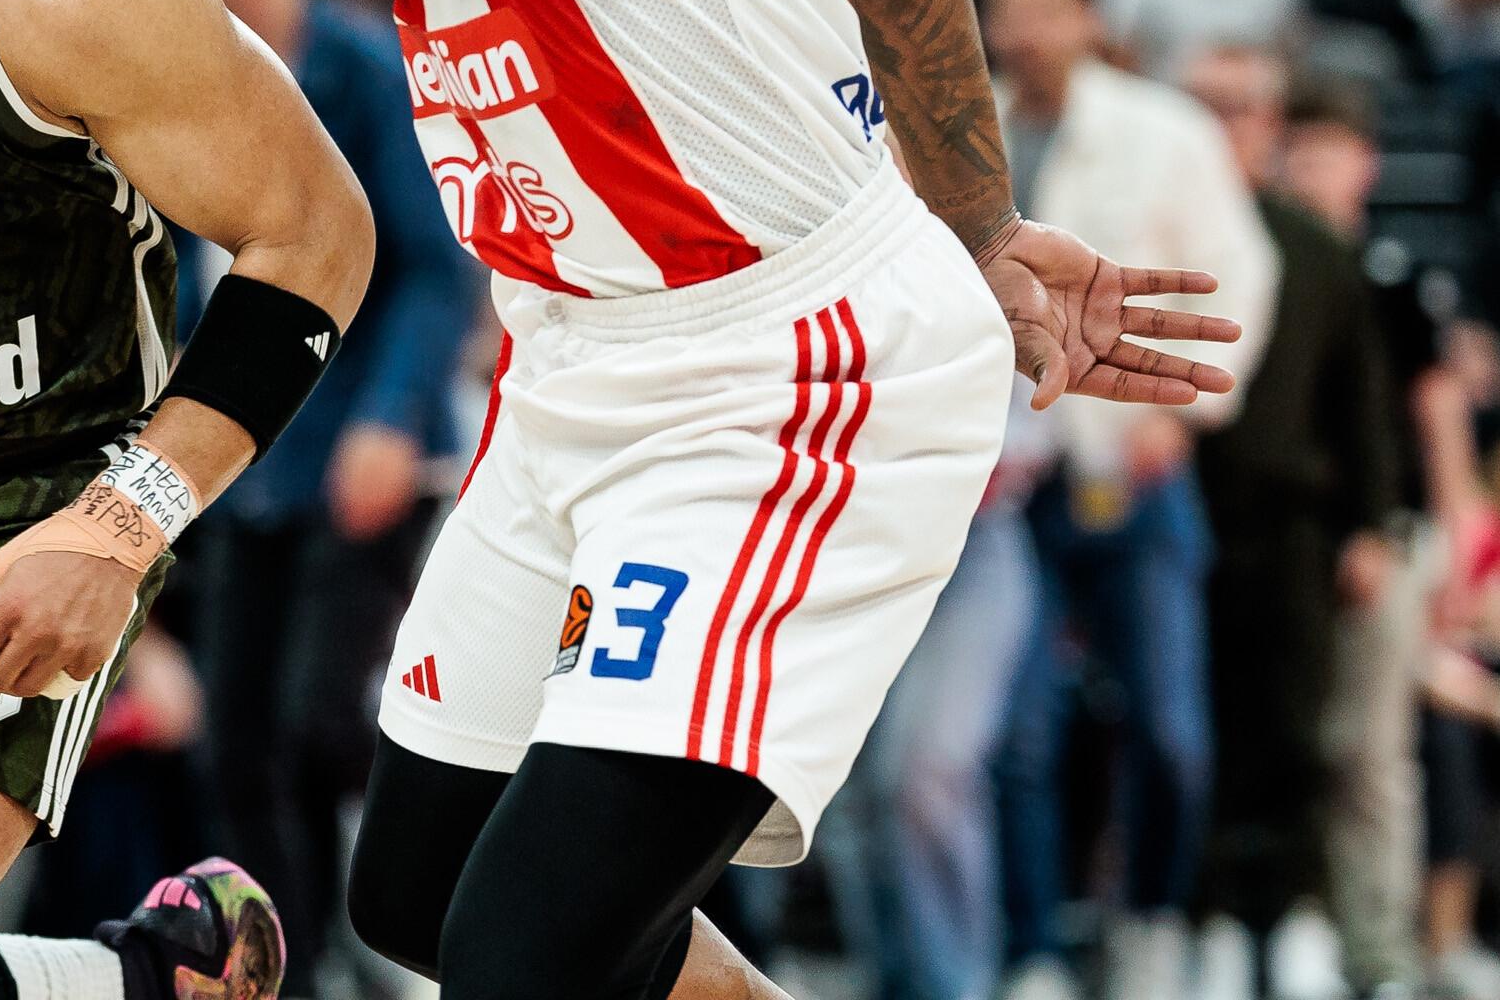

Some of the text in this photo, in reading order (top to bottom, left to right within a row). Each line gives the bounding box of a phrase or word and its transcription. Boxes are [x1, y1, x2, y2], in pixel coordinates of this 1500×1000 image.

[129, 476, 175, 532] MAMA
[143, 455, 190, 511] HELP
[590, 561, 690, 681] 3
